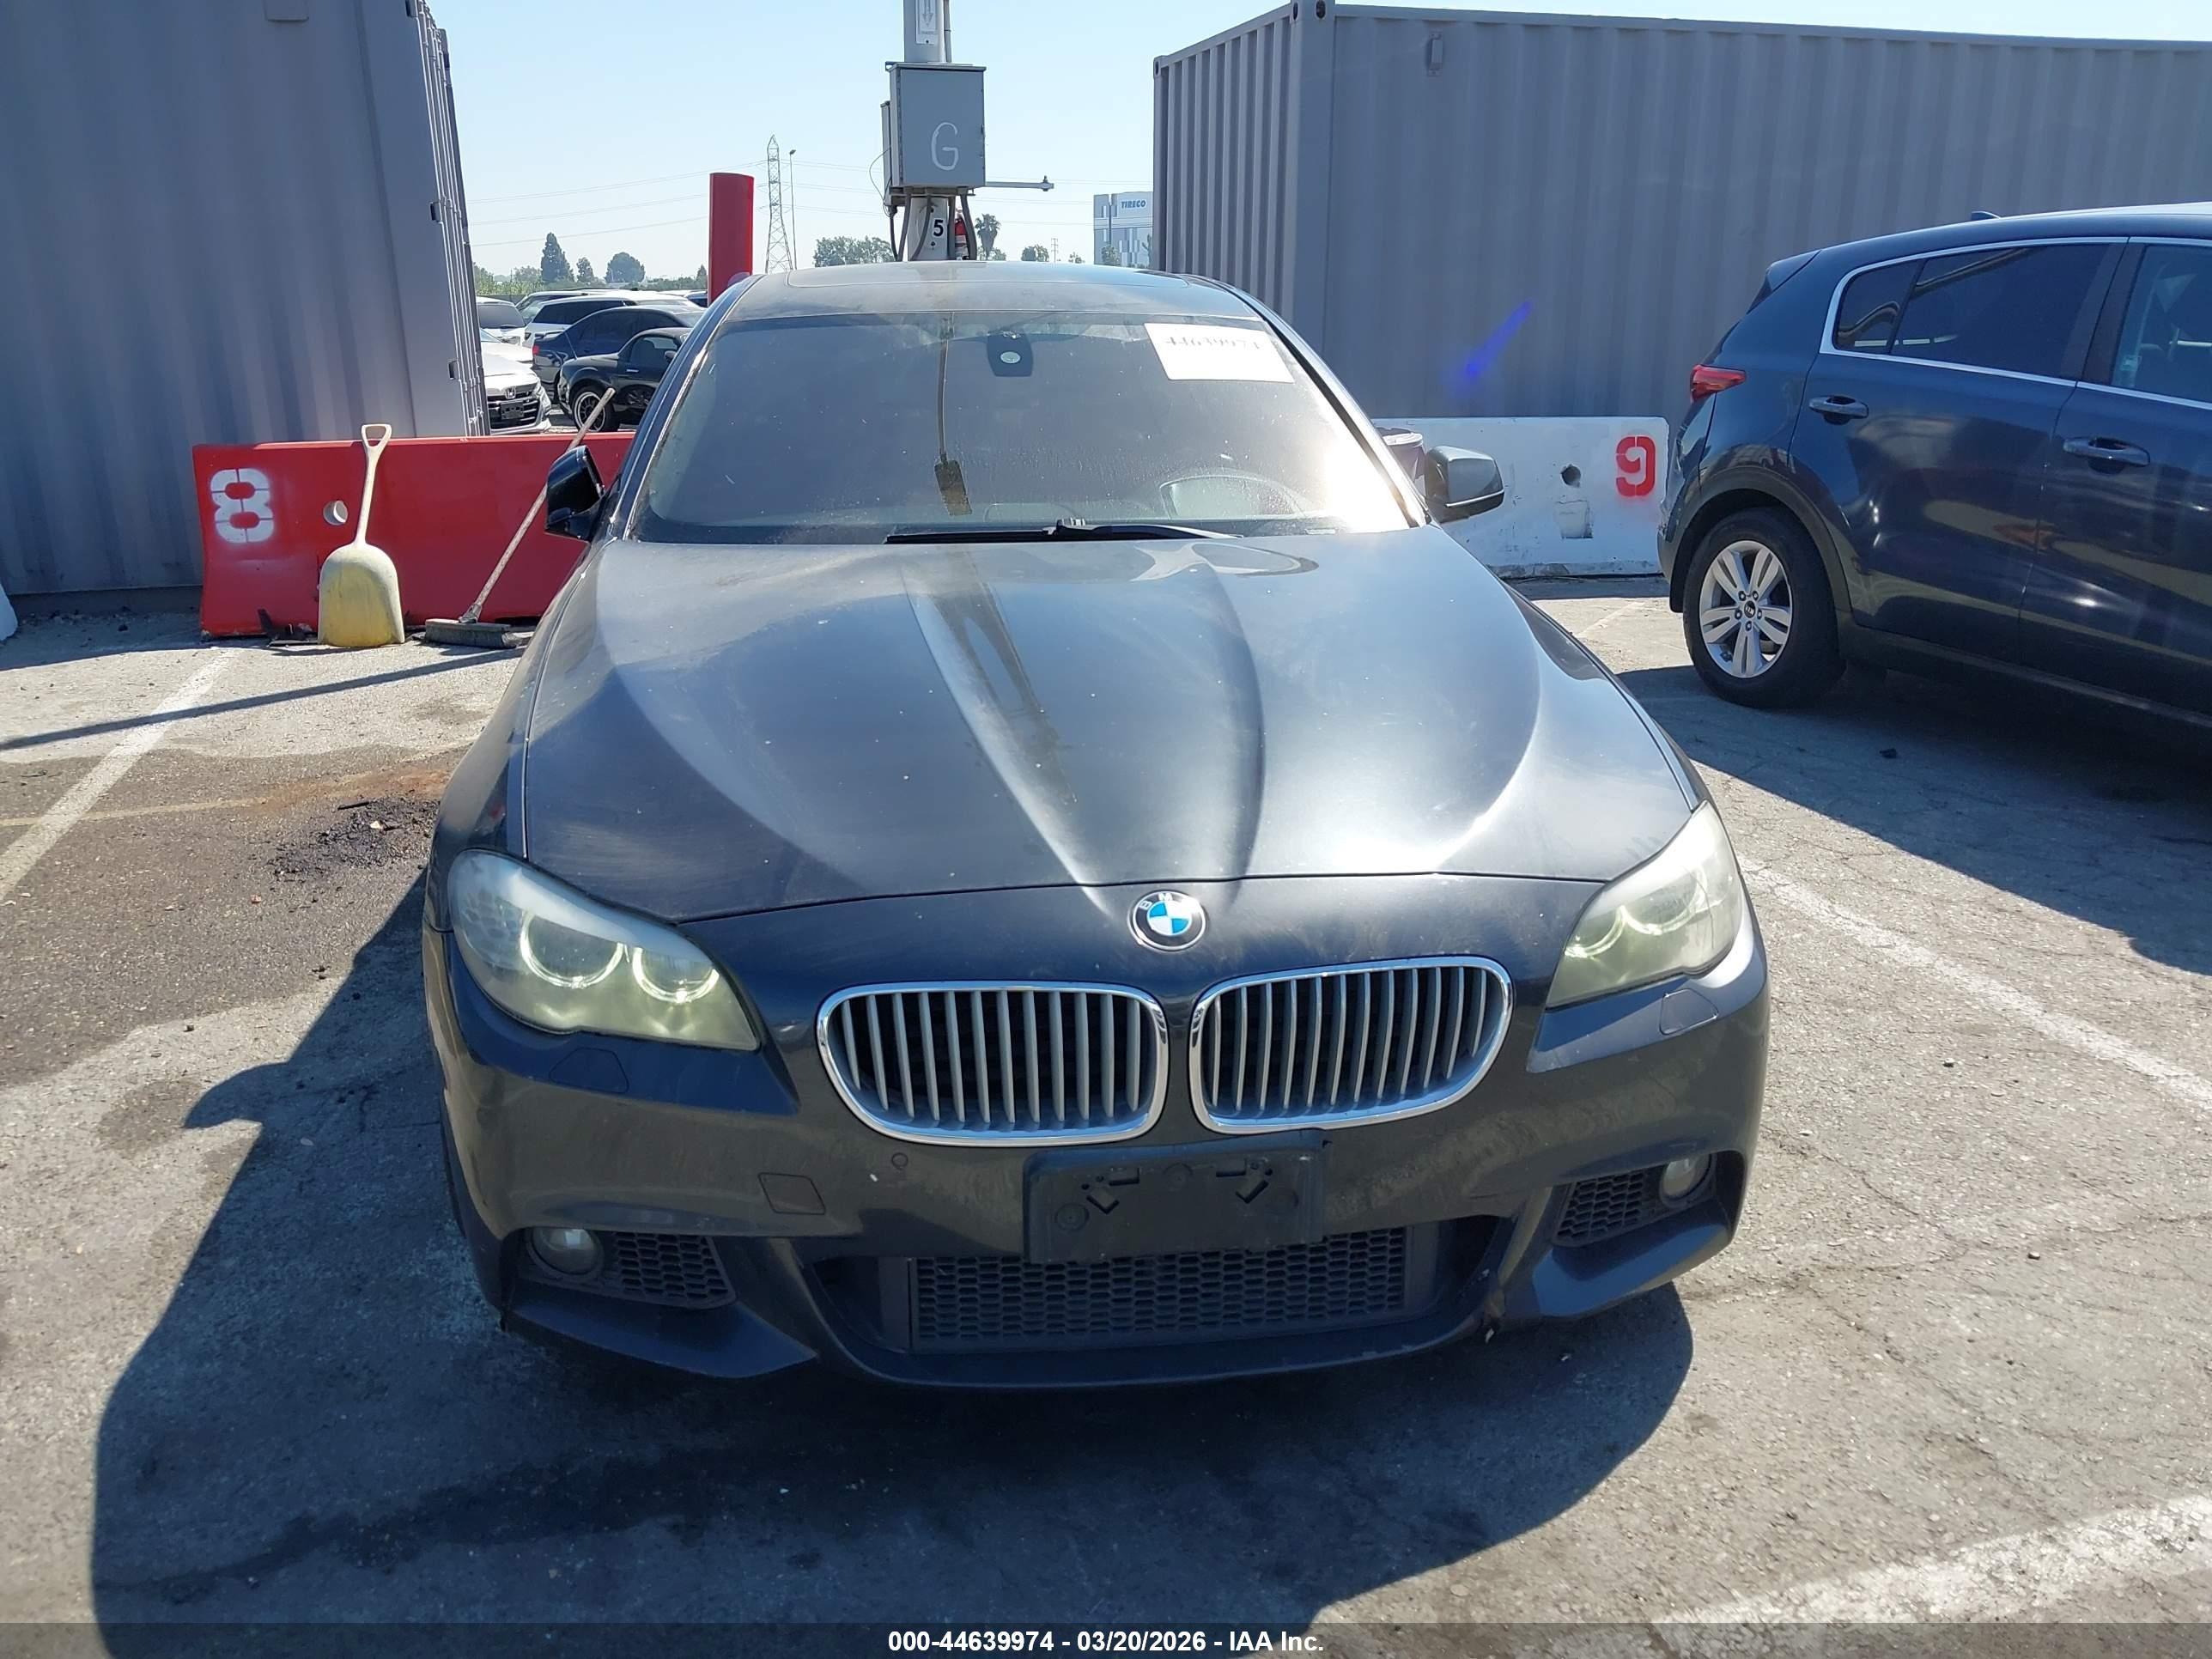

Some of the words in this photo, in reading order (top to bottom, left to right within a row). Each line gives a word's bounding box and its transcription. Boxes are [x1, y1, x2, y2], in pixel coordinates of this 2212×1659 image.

[931, 122, 959, 171] G
[933, 218, 945, 238] 5
[1121, 200, 1146, 209] TIRECO
[1615, 435, 1656, 497] 9
[210, 468, 275, 544] 8
